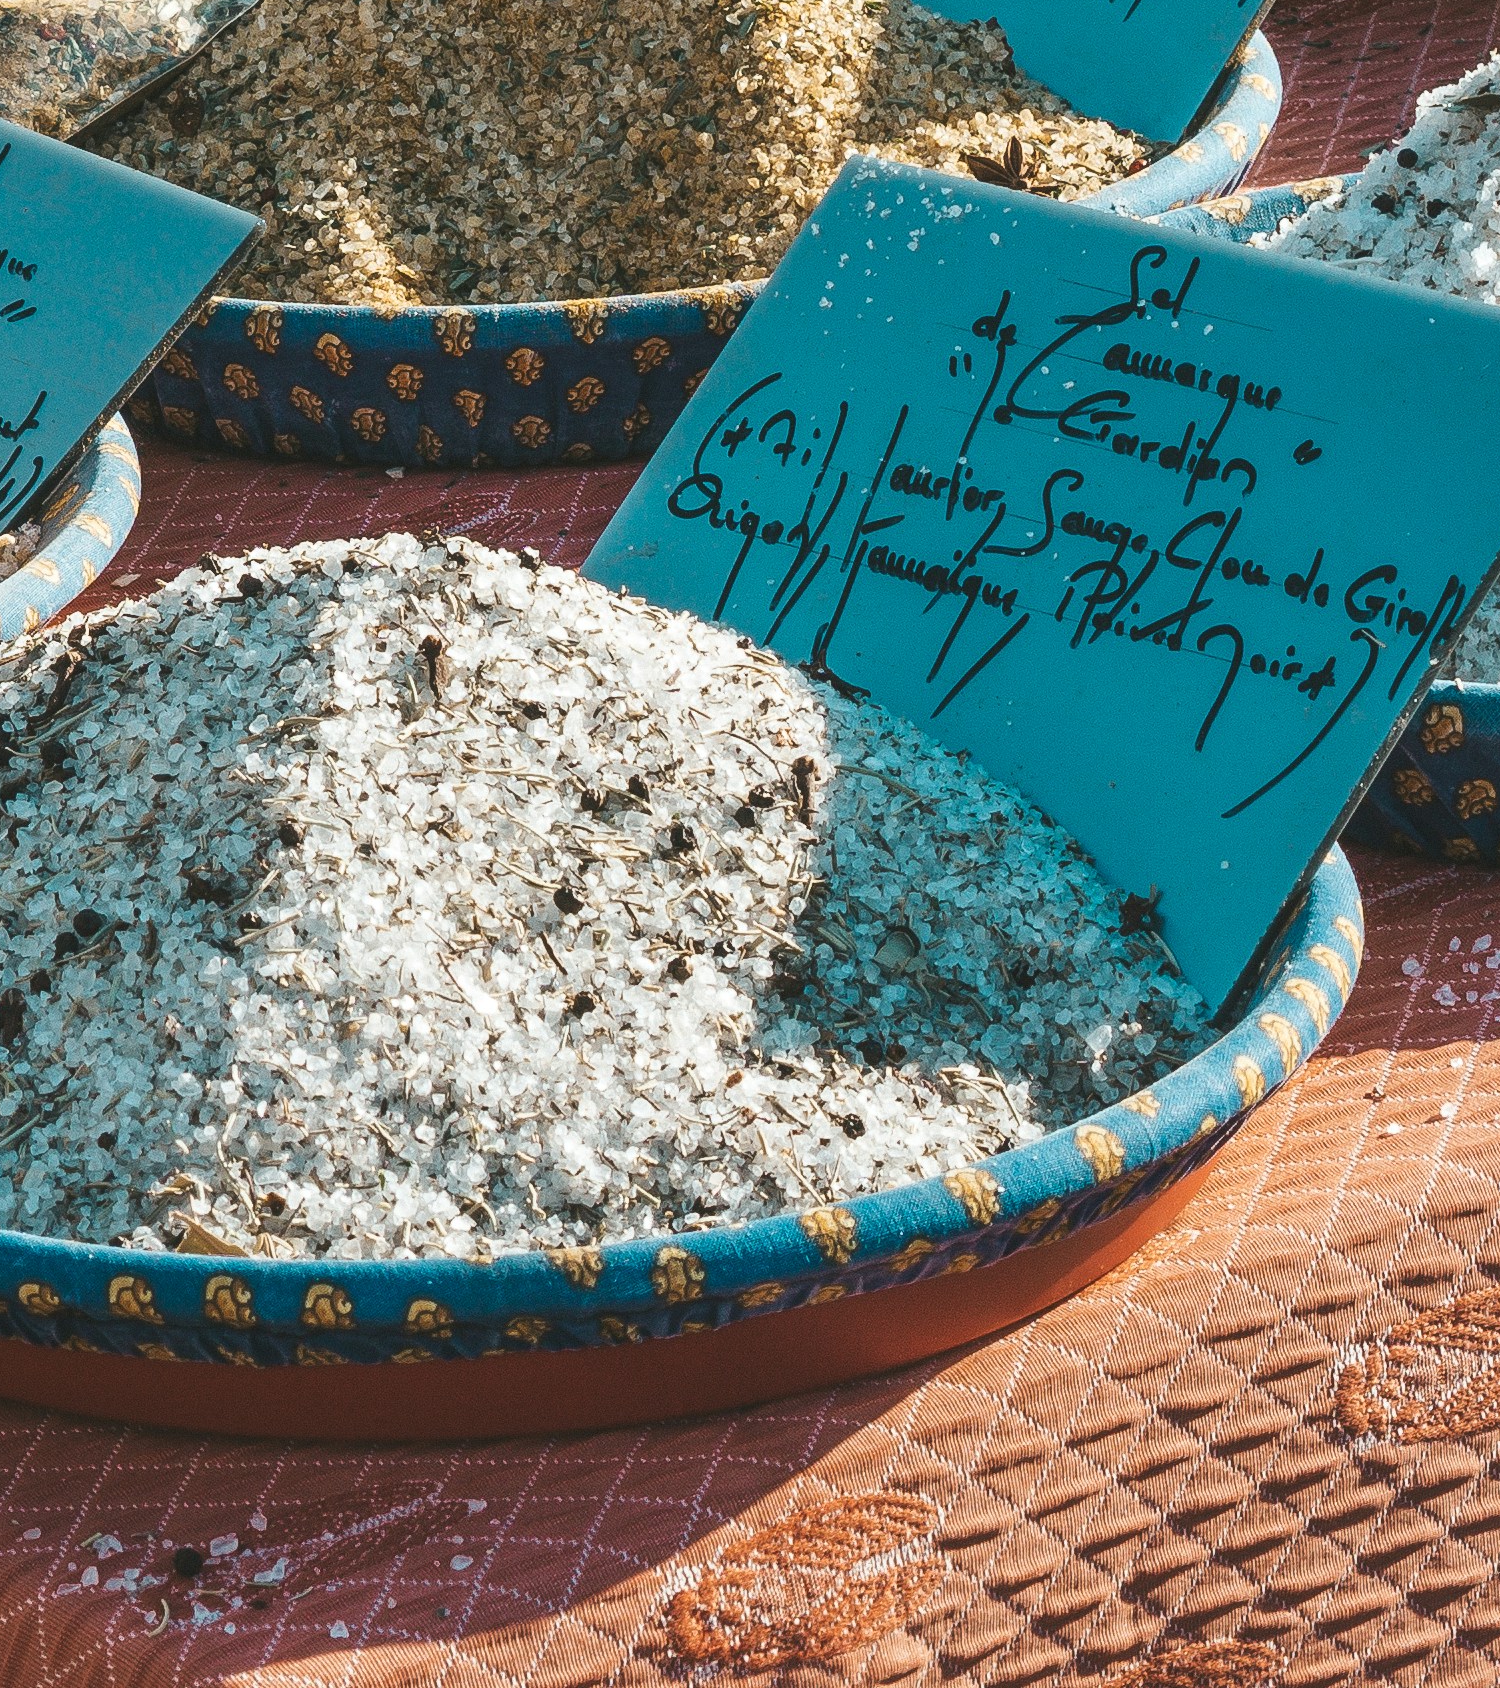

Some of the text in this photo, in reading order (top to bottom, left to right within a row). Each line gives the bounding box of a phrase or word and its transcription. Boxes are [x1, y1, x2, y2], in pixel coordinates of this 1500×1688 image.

[1055, 245, 1200, 324] Sel
[973, 290, 1017, 347] de
[1284, 548, 1329, 606] de
